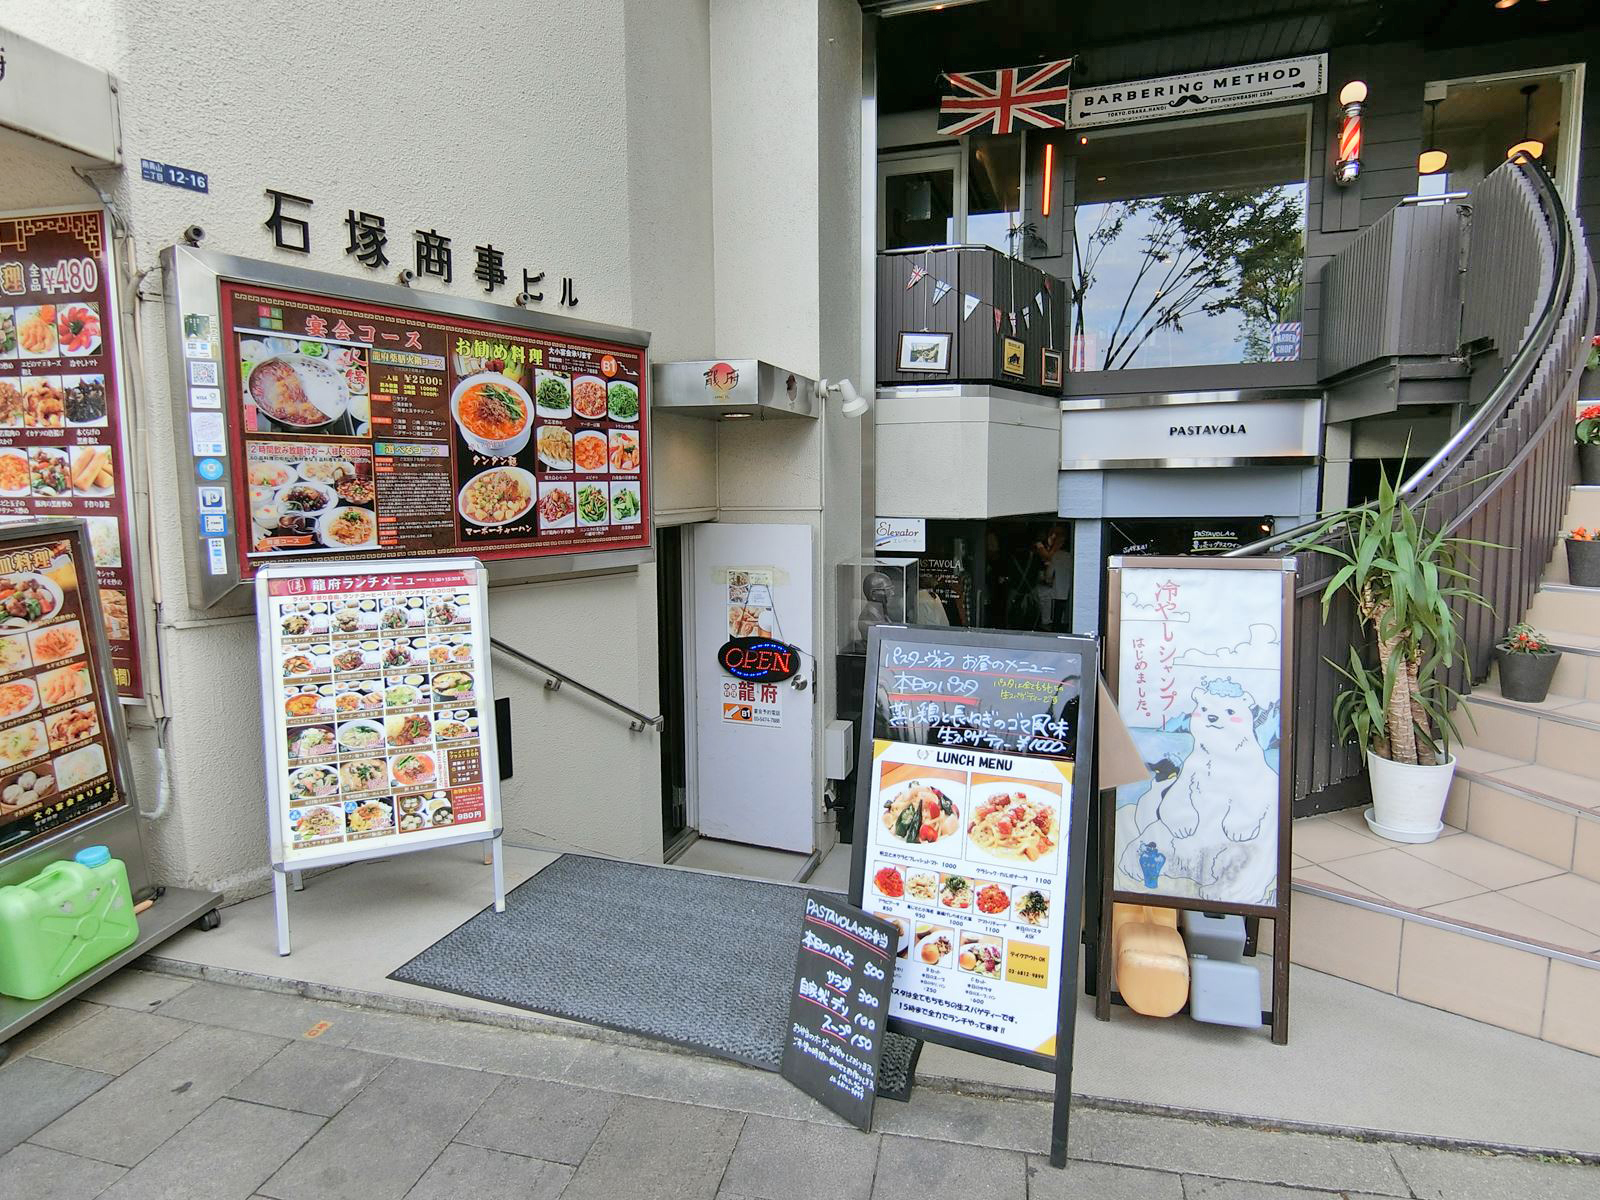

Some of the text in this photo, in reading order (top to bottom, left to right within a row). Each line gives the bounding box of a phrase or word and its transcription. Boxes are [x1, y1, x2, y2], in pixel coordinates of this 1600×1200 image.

[1084, 67, 1302, 107] BARBERING METHOD
[143, 170, 164, 182] 二丁目
[169, 169, 206, 188] 12-16
[265, 188, 579, 307] 石塚商事ビル
[29, 263, 41, 292] 全品
[41, 257, 98, 295] ¥480
[305, 314, 423, 350] 宴会コース
[455, 337, 544, 367] お勧め料理
[603, 359, 618, 374] B1
[404, 374, 439, 386] ¥2500
[1169, 424, 1247, 437] PASTAVOLA
[876, 521, 920, 537] Elevator
[312, 576, 427, 592] 龍府ランチメニュー
[725, 647, 792, 673] OPEN
[962, 654, 1057, 674] お昼のメニュー
[1155, 579, 1181, 731] 冷やしシャンプー
[893, 670, 979, 697] 本日のパスタ
[1132, 637, 1152, 718] はじめました。
[738, 680, 779, 704] 龍府
[741, 708, 752, 719] B1
[935, 750, 1014, 772] LUNCH MENU
[941, 861, 957, 870] 1000
[1034, 876, 1052, 886] 1100
[914, 911, 927, 920] 950
[949, 919, 964, 928] 1000
[984, 925, 1000, 935] 1100
[863, 961, 885, 981] 500
[826, 969, 879, 1007] サラダ 300
[854, 1012, 876, 1031] 100
[821, 1014, 873, 1051] スープ 150
